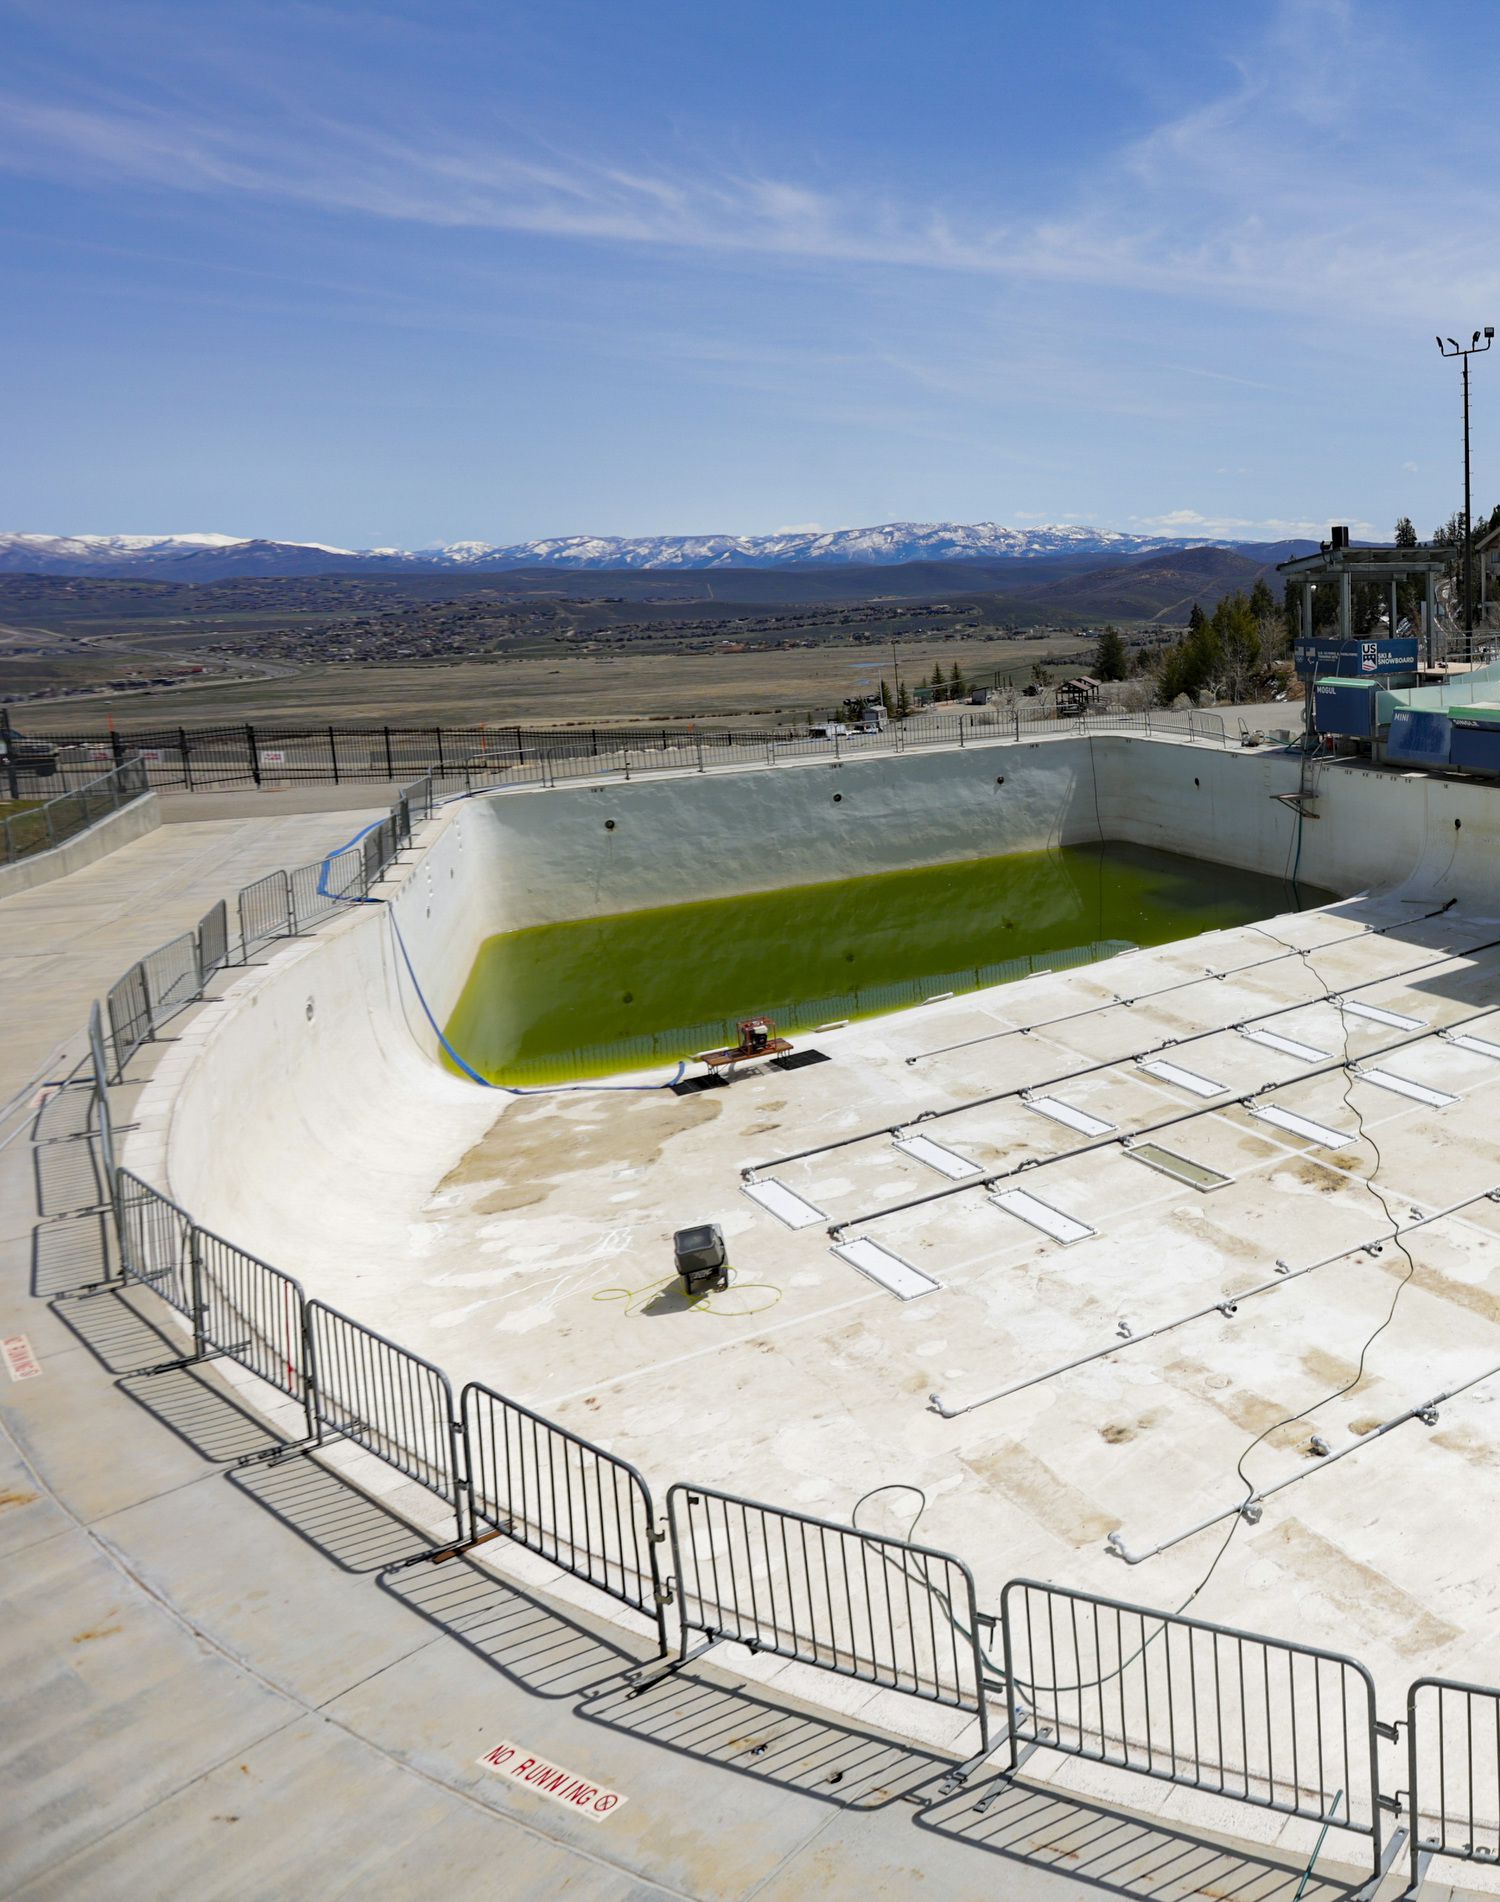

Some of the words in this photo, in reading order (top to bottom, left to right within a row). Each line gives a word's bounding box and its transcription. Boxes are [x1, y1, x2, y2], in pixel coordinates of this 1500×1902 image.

[1362, 644, 1376, 654] US
[1378, 656, 1414, 665] SNOWBOARD
[1316, 686, 1336, 695] MOGUL
[1394, 713, 1409, 722] MINI
[484, 1744, 515, 1766] NO
[511, 1758, 597, 1807] RUNNING
